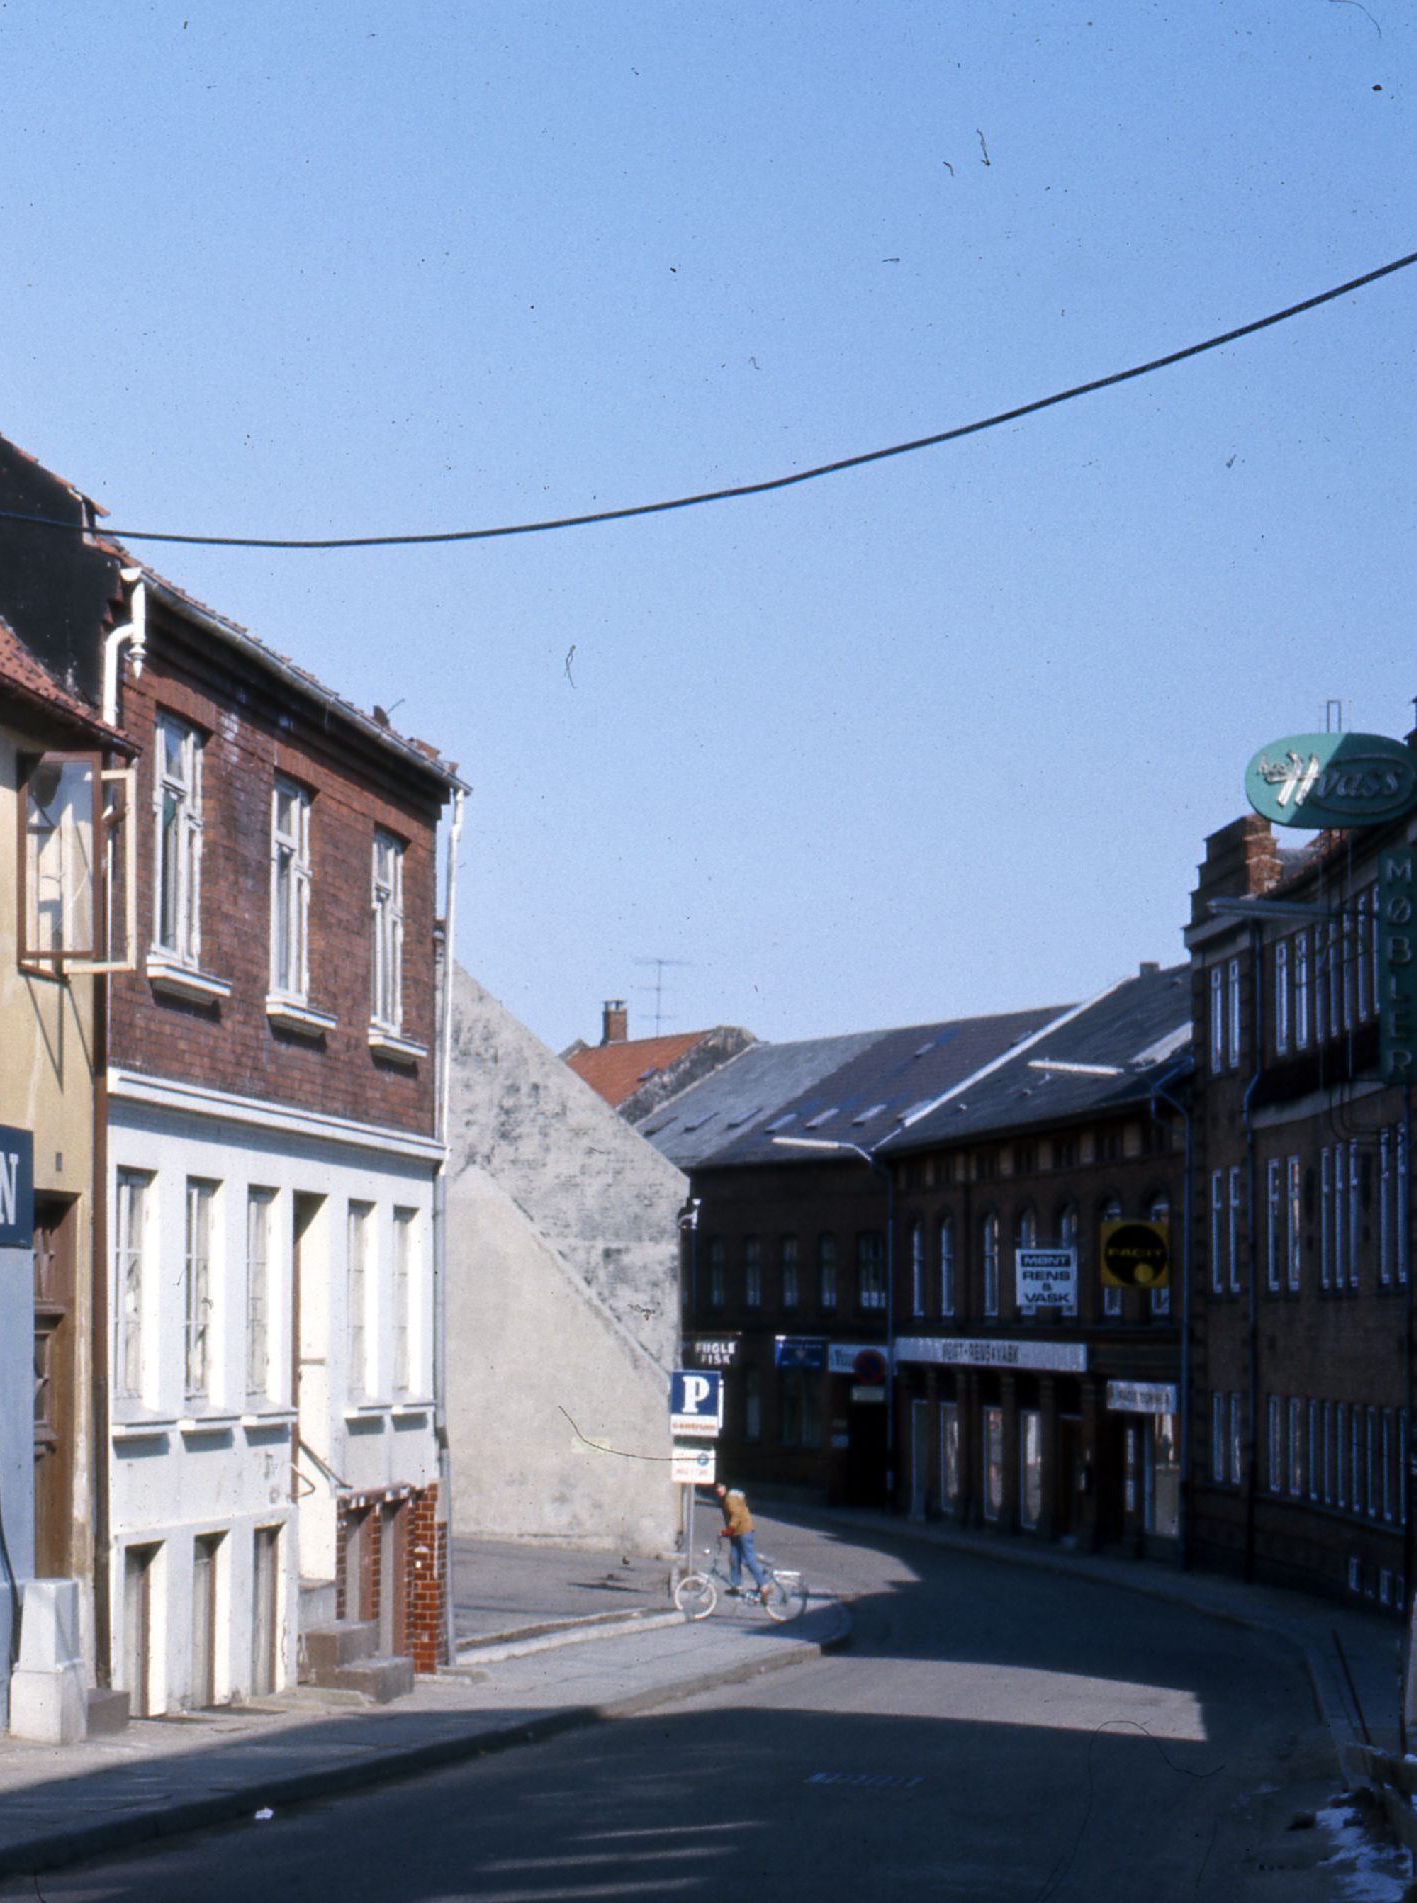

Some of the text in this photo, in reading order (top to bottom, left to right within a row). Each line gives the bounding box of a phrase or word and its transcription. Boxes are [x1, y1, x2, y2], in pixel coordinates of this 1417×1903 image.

[1386, 857, 1413, 1076] MØBLER
[1022, 1270, 1070, 1281] RENS
[1024, 1292, 1070, 1303] VASK
[682, 1375, 710, 1414] P
